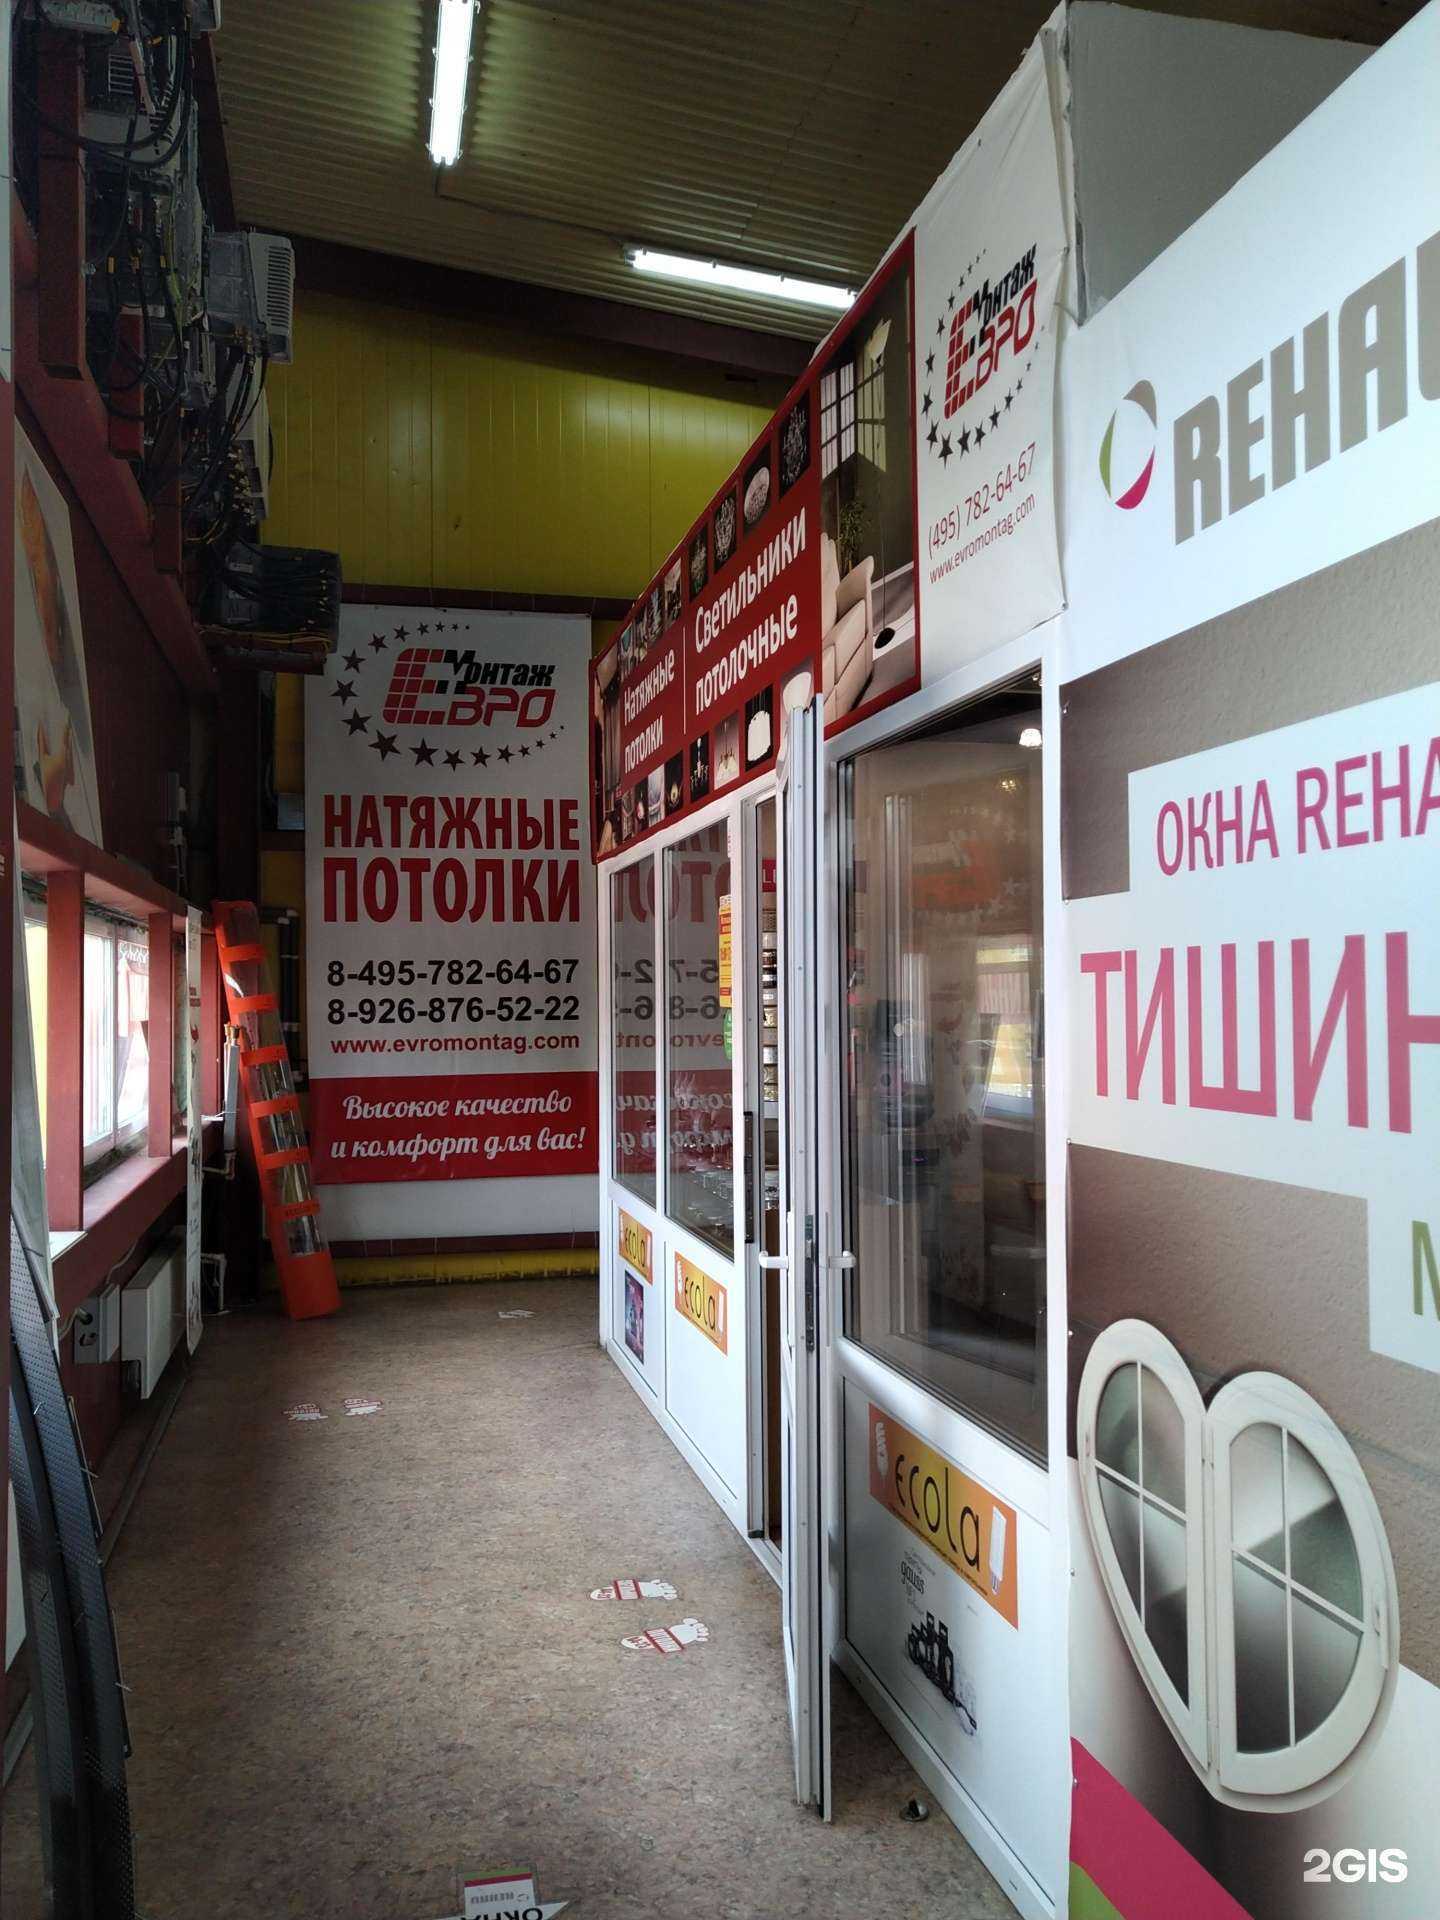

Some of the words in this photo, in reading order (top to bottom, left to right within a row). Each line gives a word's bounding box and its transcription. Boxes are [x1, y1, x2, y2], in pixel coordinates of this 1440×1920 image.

[928, 504, 961, 560] (495)
[964, 441, 1036, 526] 782-64-67
[929, 493, 1036, 584] www.evromontag.com
[695, 506, 806, 653] Светильники
[695, 594, 798, 716] потолочные
[624, 648, 675, 726] Натяжные
[624, 715, 664, 774] потолки
[323, 794, 581, 851] НАТЯЖНЫЕ
[1156, 778, 1280, 877] ОКНА
[323, 856, 581, 923] ПОТОЛКИ
[327, 959, 579, 987] 8-495-782-64-67
[327, 996, 579, 1025] 8-926-876-52-22
[331, 1033, 579, 1055] www.evromontag.com
[342, 1094, 449, 1120] Высокое
[454, 1089, 572, 1117] качество
[330, 1138, 346, 1158] и
[351, 1133, 479, 1162] комфорт
[483, 1135, 532, 1160] для
[536, 1126, 586, 1151] вас!
